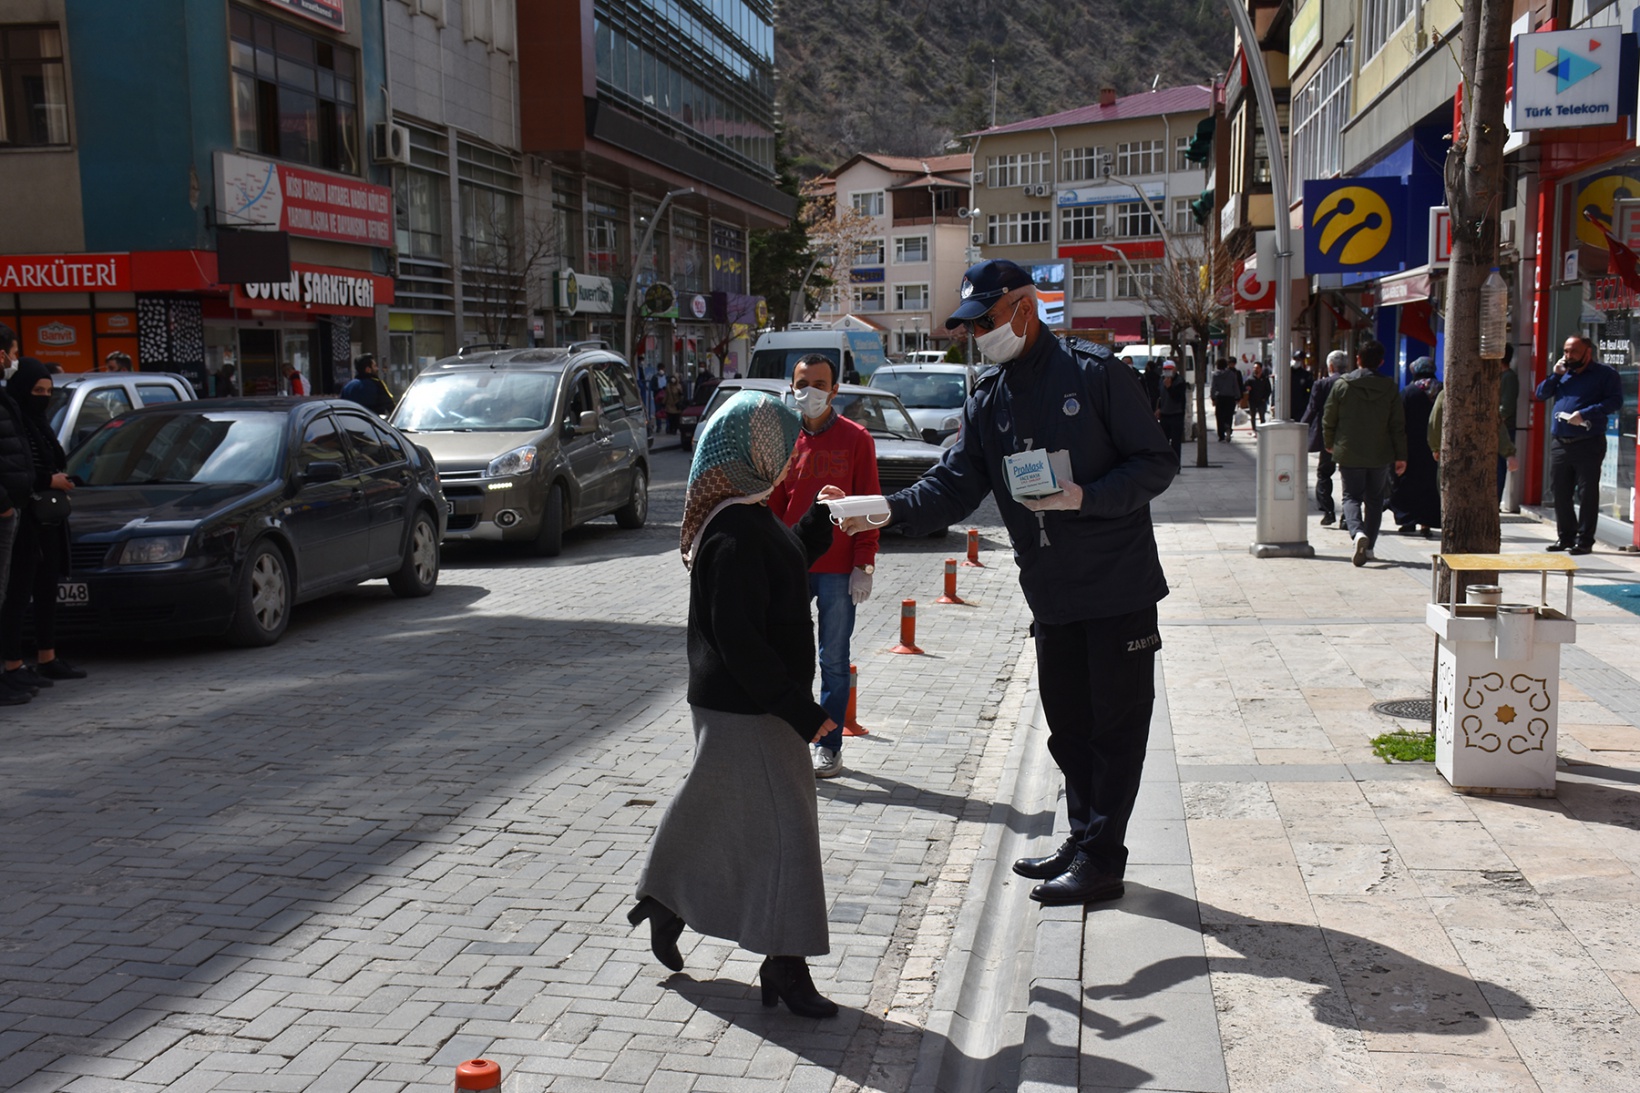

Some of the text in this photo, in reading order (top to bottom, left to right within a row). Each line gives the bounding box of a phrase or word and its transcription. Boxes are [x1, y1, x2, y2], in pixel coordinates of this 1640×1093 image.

[1525, 103, 1609, 118] Türk Telekom
[285, 171, 303, 198] İKİSU
[350, 187, 367, 210] VADİSİ
[368, 189, 388, 214] KÖYLERİ
[287, 206, 389, 241] YARDIMLAŞMA VE DAYANIŞMA DERNEĞİ
[0, 259, 116, 287] ARKÜTERİ
[304, 272, 374, 309] ŞARKÜTERİ
[41, 330, 73, 340] Banvit
[1013, 460, 1044, 476] ProMask
[58, 585, 87, 601] 048
[1127, 634, 1160, 652] ZABITA
